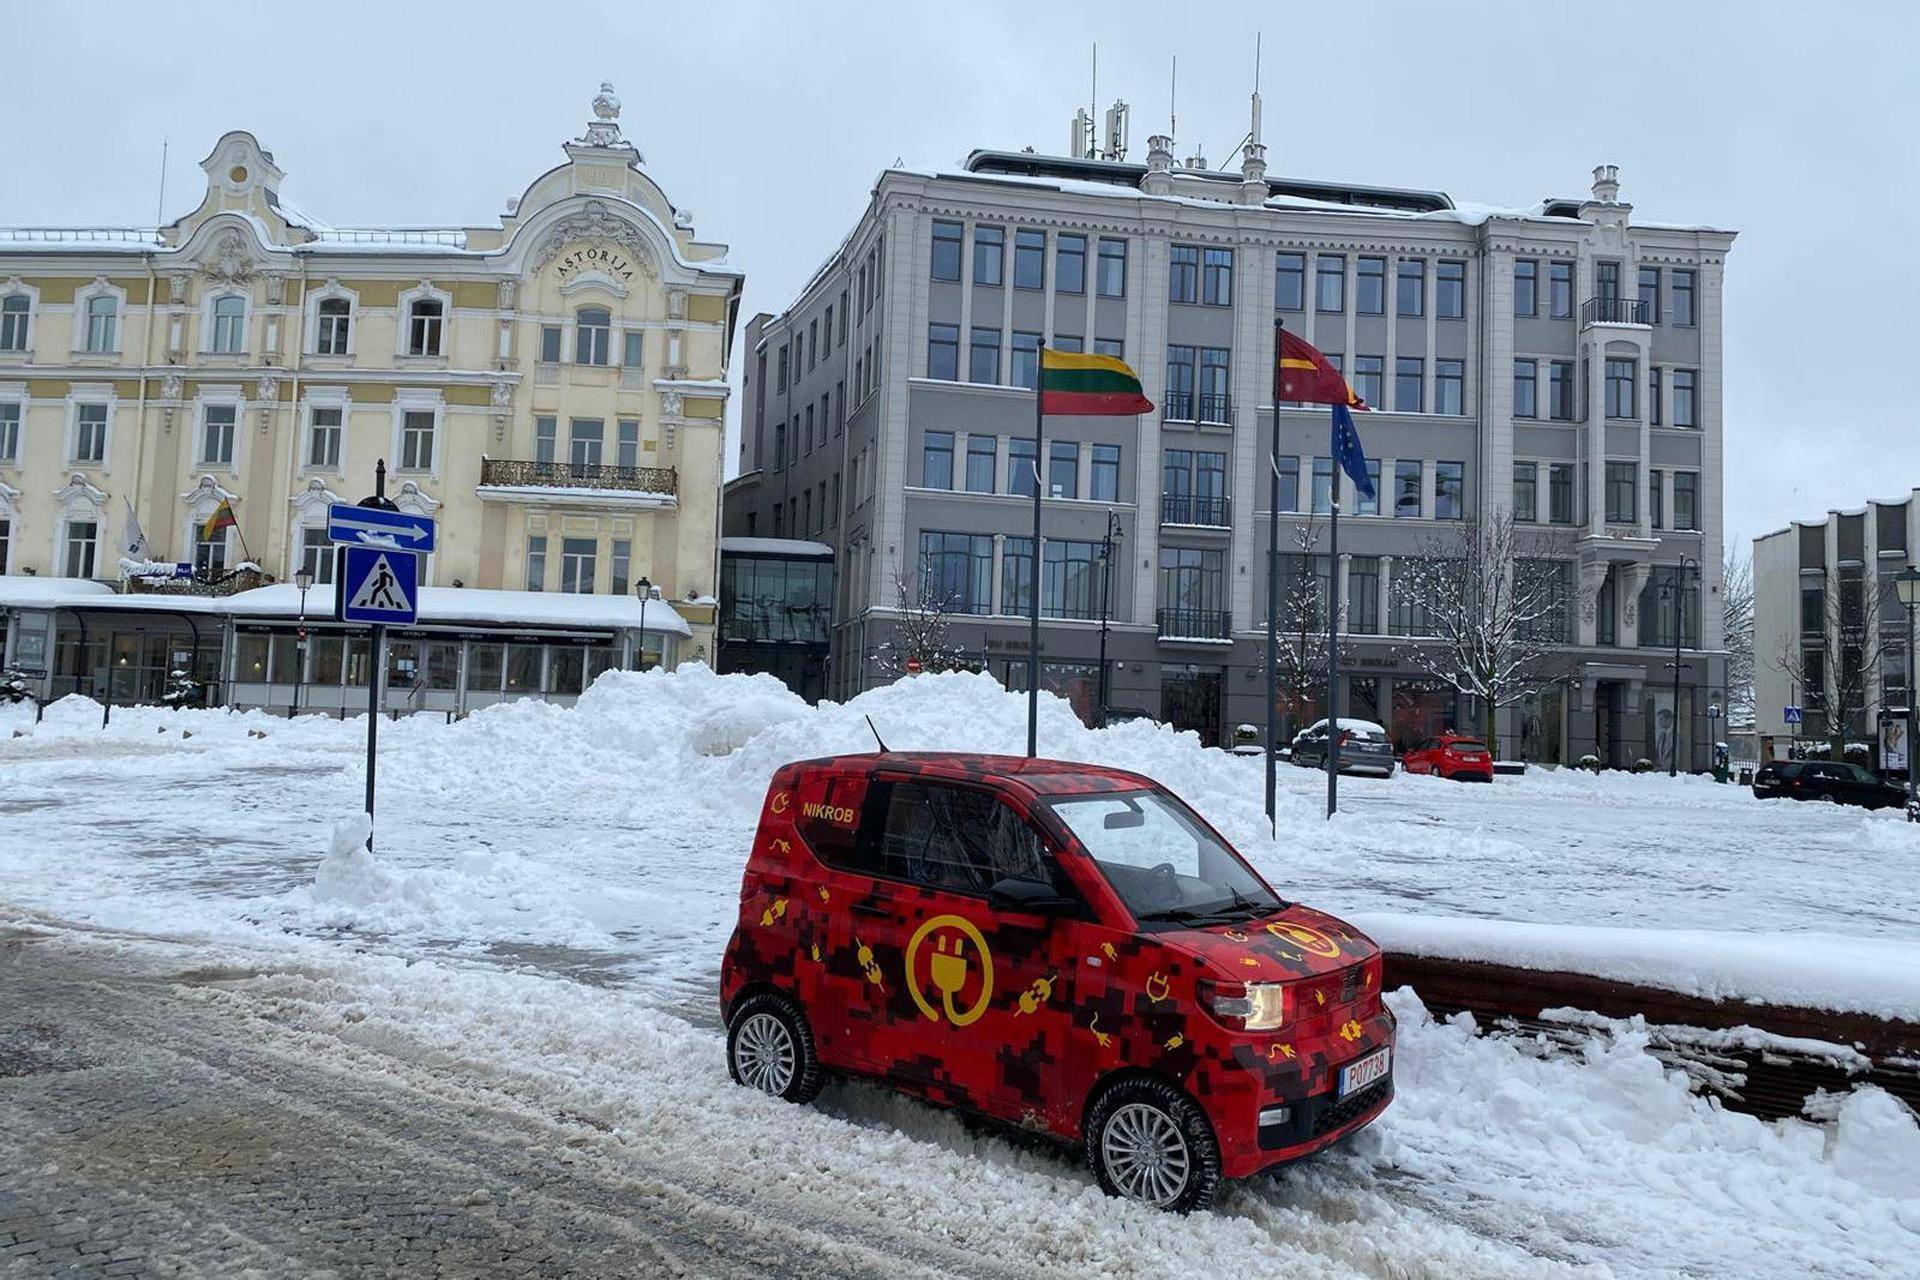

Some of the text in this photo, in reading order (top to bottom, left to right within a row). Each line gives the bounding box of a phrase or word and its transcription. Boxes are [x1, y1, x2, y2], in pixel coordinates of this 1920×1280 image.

[558, 248, 633, 280] ASTORIJA
[802, 802, 854, 823] NIKROB
[1350, 1052, 1385, 1090] P07738
